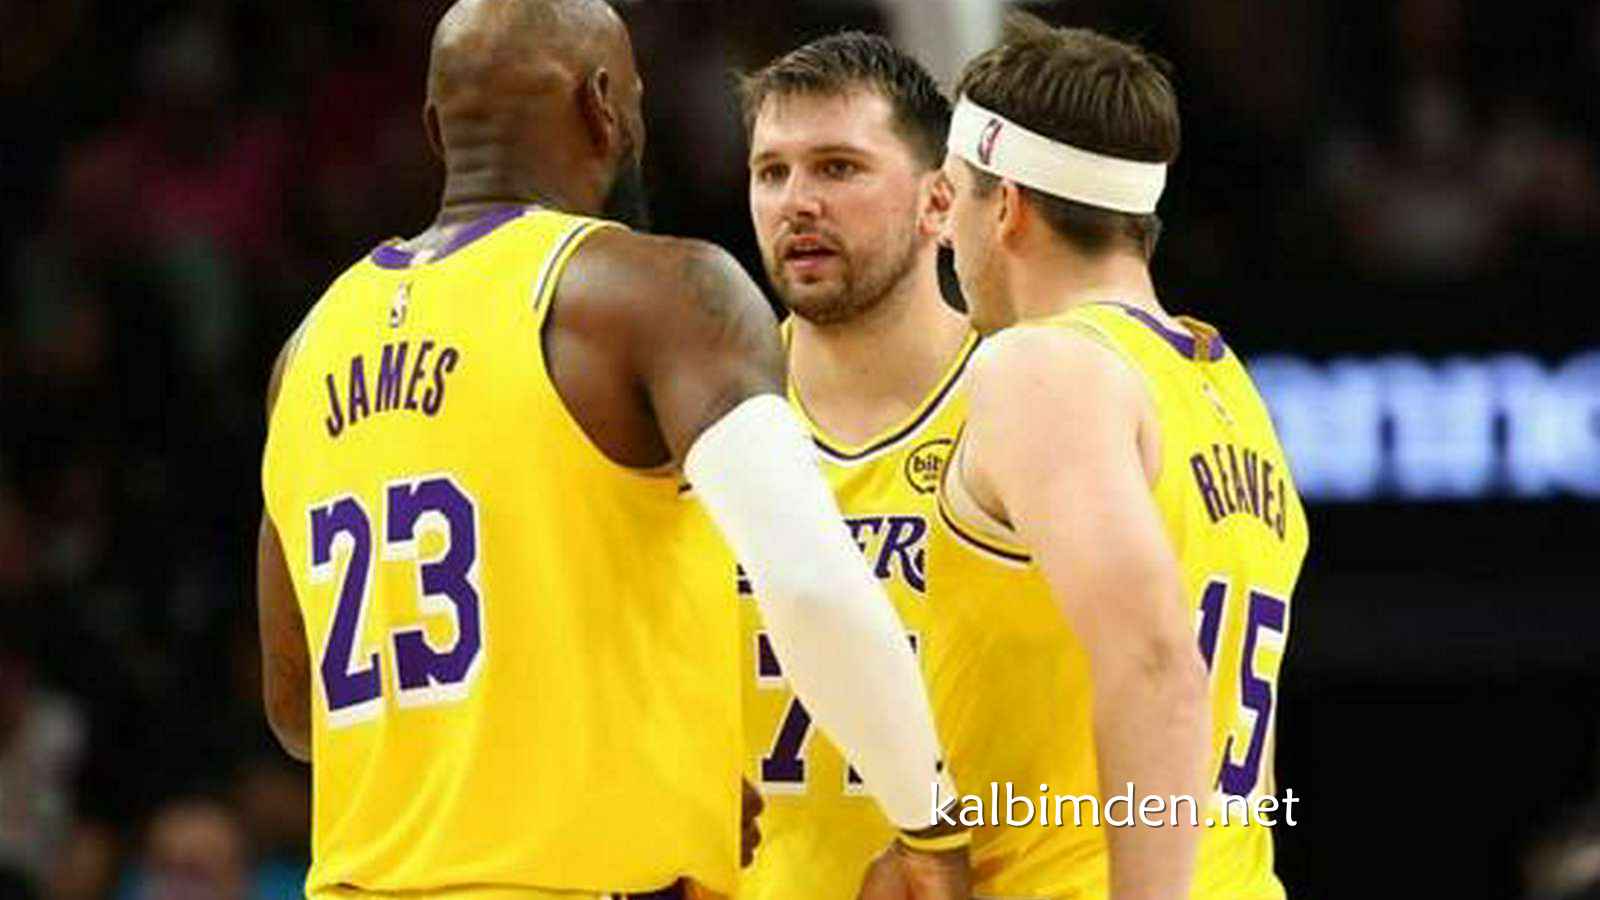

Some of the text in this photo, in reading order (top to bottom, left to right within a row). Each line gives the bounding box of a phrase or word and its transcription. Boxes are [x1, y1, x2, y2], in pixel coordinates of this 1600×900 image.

[324, 340, 459, 438] JAMES
[309, 476, 483, 718] 23
[1197, 577, 1286, 799] 15
